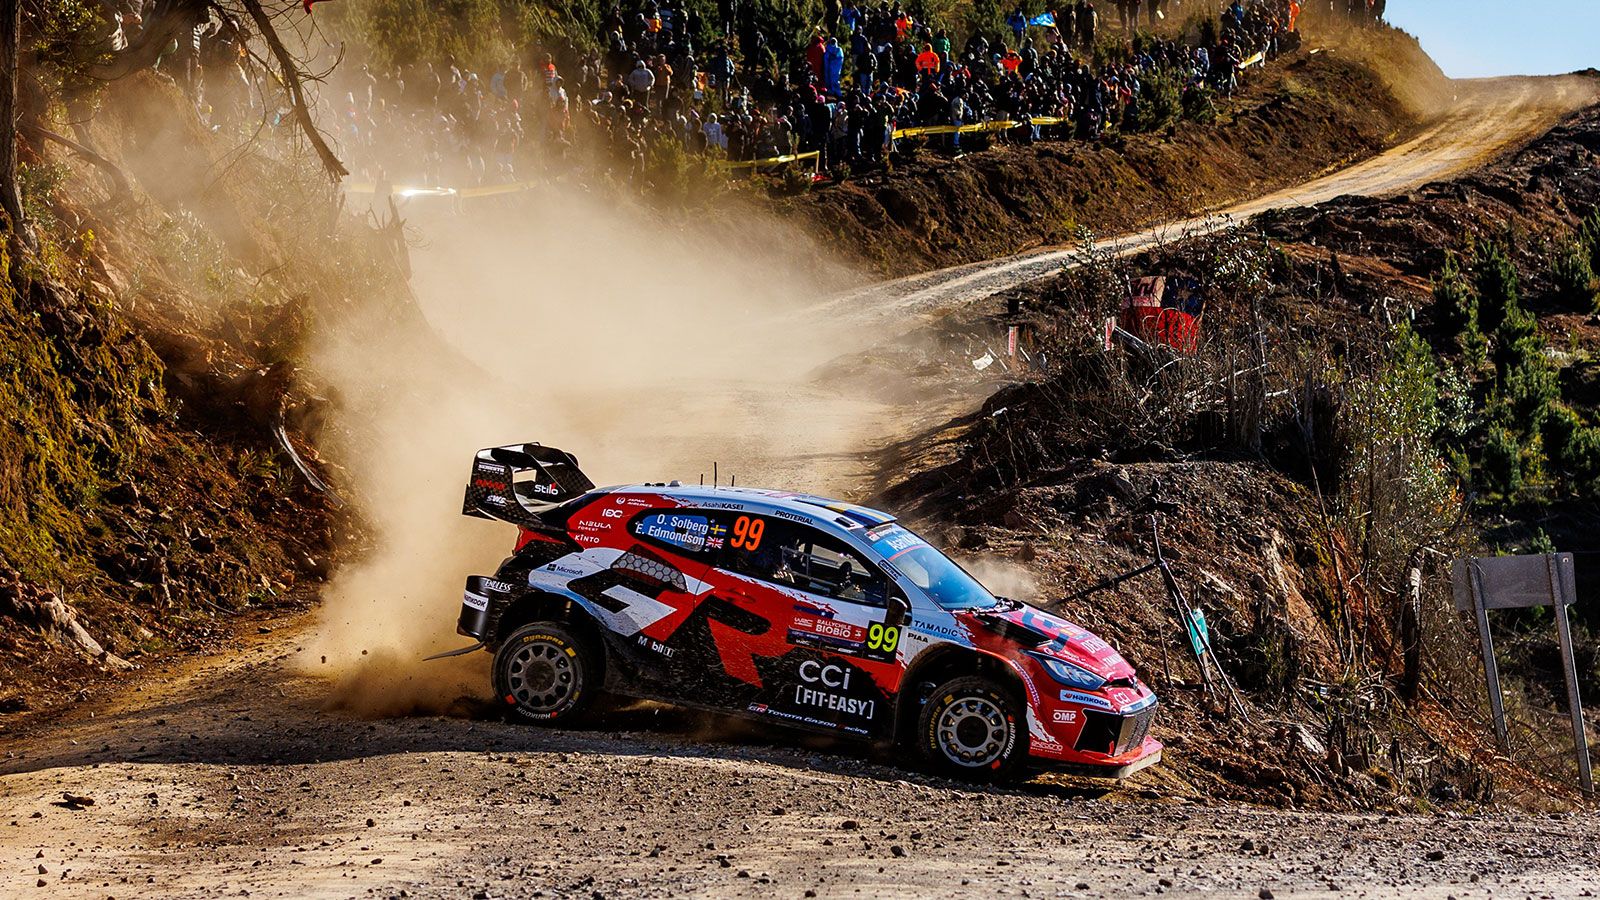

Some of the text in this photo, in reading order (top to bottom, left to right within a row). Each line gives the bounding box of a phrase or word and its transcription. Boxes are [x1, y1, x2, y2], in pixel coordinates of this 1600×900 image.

[656, 514, 709, 535] O. Solberg
[774, 509, 814, 525] PROTERIAL
[635, 523, 705, 546] E. Edmondson
[730, 515, 765, 551] 99
[557, 565, 584, 576] Microsoft
[485, 579, 513, 592] ENDLESS
[914, 620, 958, 637] TAMADIC
[867, 623, 899, 652] 99
[908, 633, 929, 643] PIAA
[1053, 712, 1077, 721] OMP
